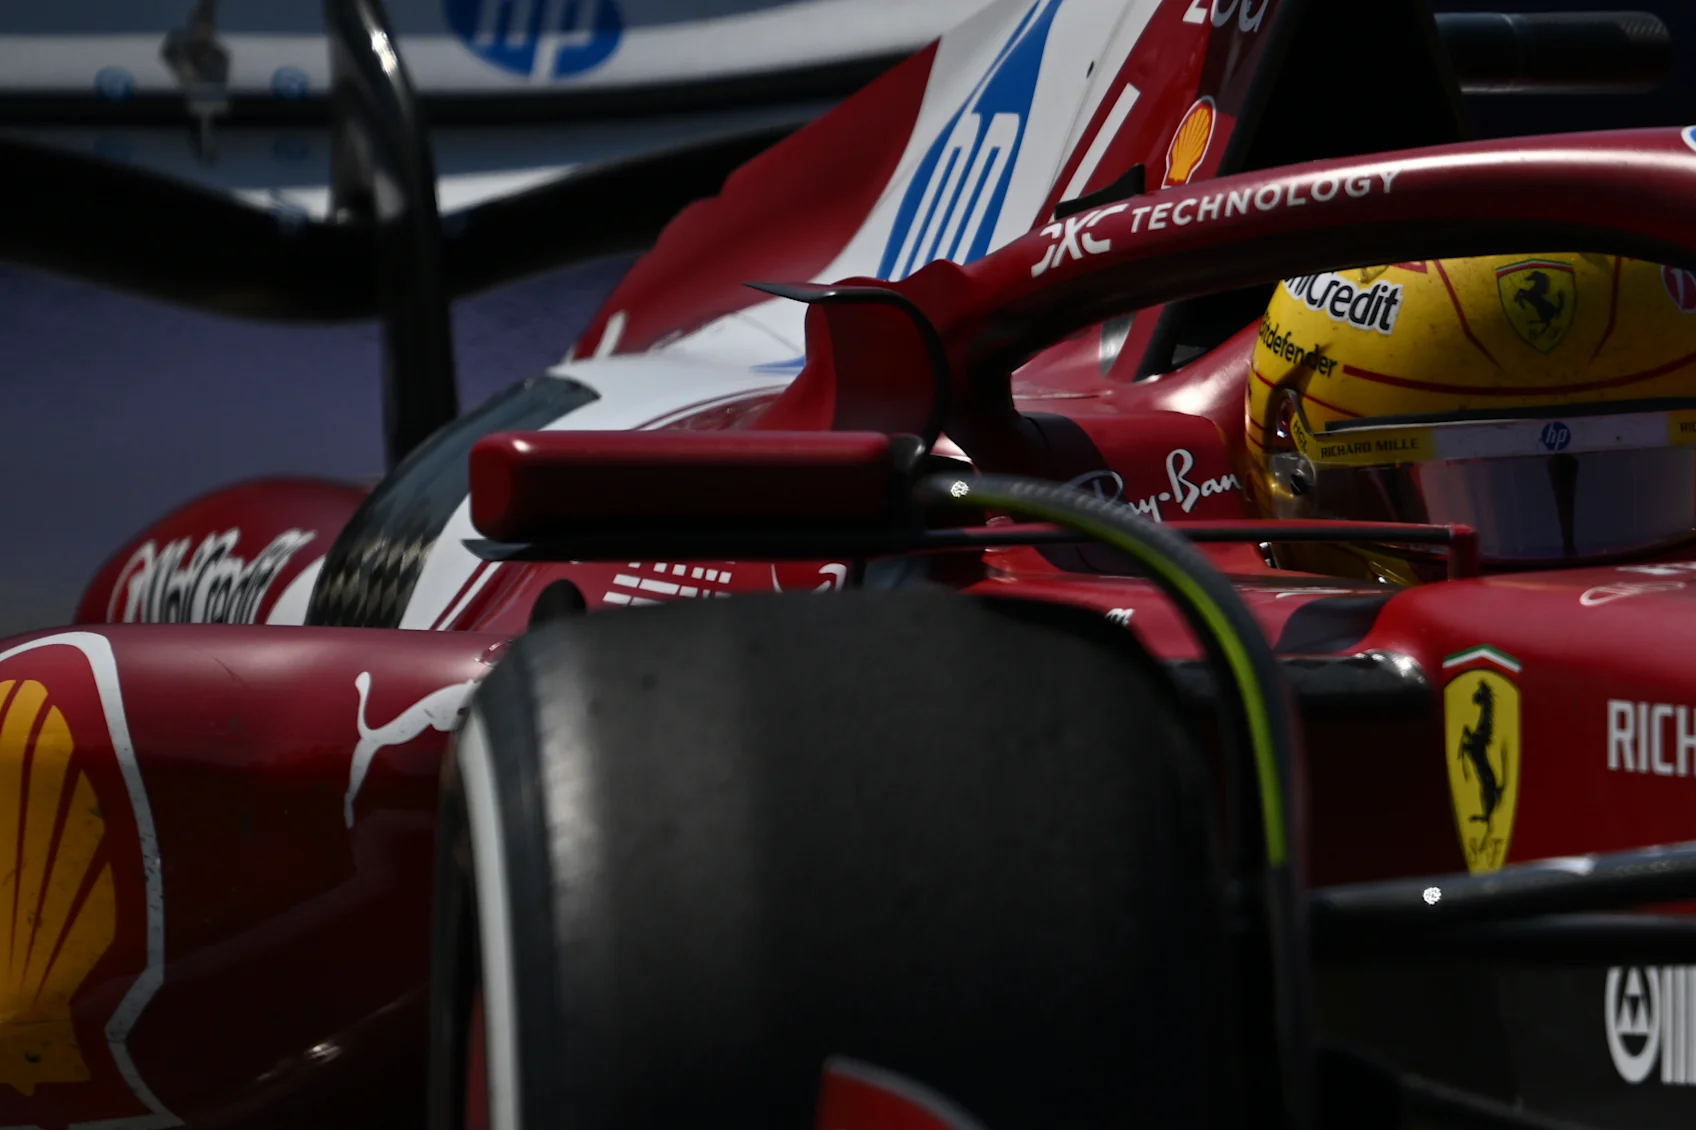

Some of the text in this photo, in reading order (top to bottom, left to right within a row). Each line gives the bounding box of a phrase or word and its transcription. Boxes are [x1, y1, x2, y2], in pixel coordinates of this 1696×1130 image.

[1130, 170, 1402, 234] TECHNOLOGY
[1284, 274, 1400, 331] niCredit
[1321, 438, 1419, 459] RICHARD MILLE
